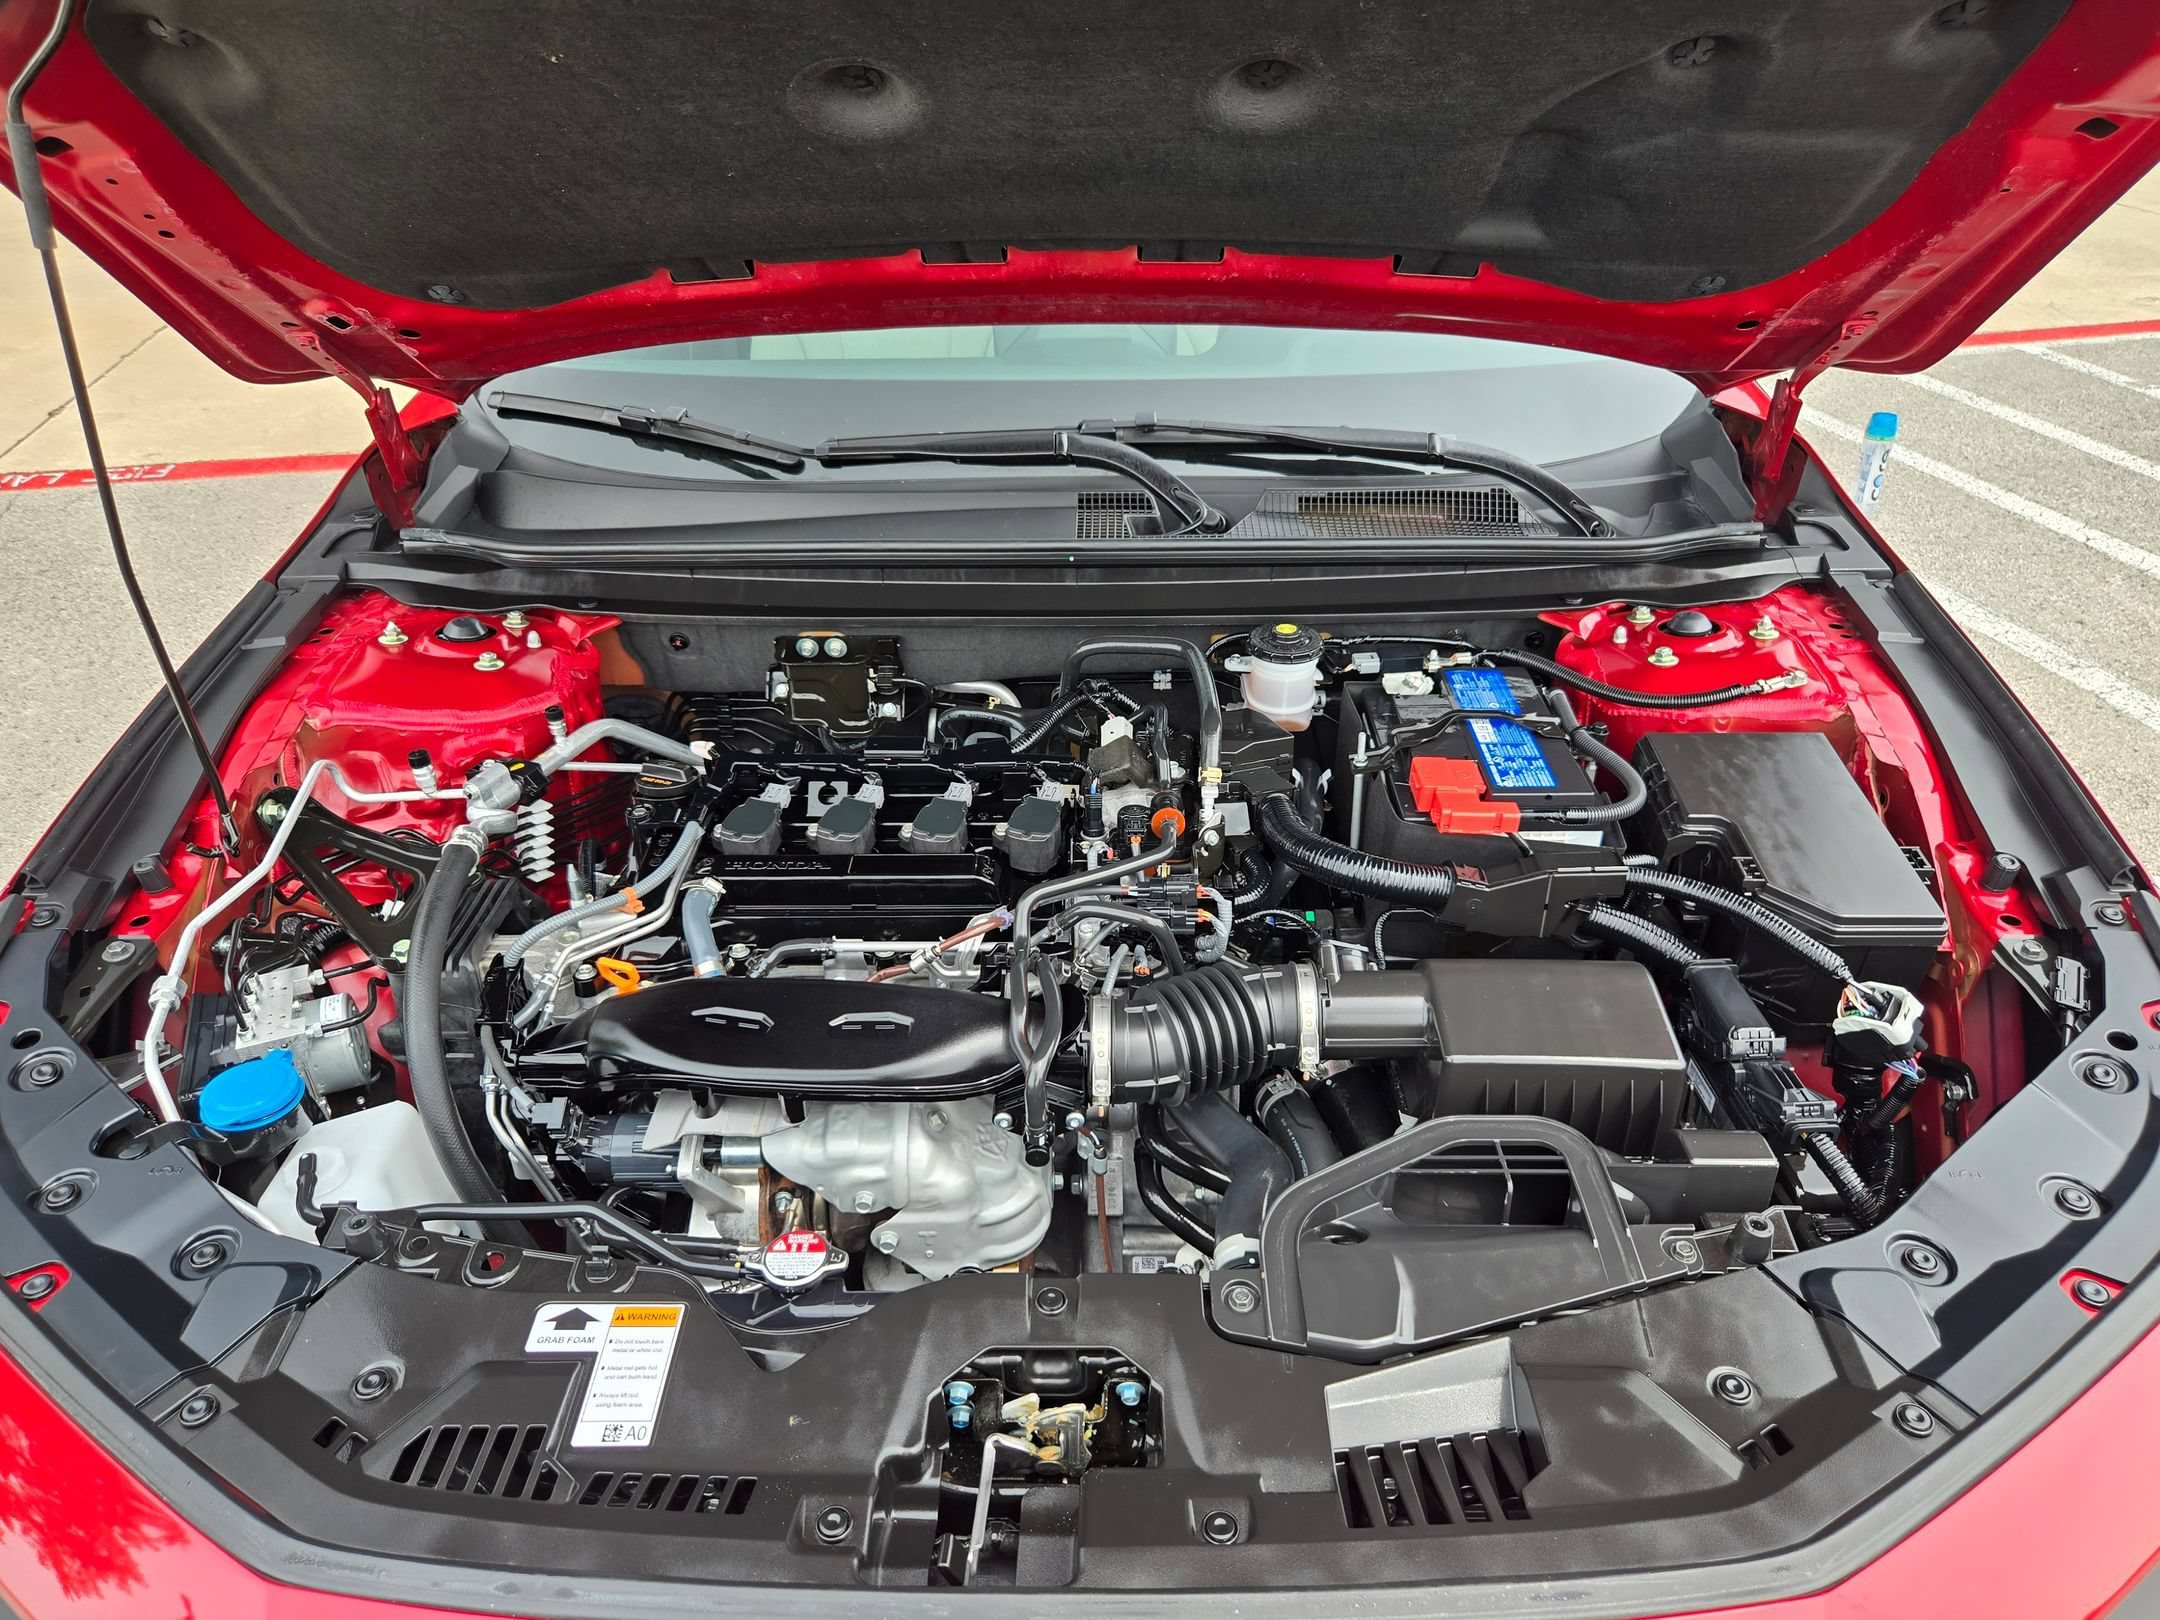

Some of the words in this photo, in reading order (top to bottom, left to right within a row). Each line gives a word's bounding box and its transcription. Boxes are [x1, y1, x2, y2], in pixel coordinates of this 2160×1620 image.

[724, 861, 831, 870] HONDA
[627, 1312, 677, 1321] WARNING
[537, 1336, 565, 1344] GRAB
[566, 1336, 596, 1344] FOAM
[624, 1425, 648, 1441] A0
